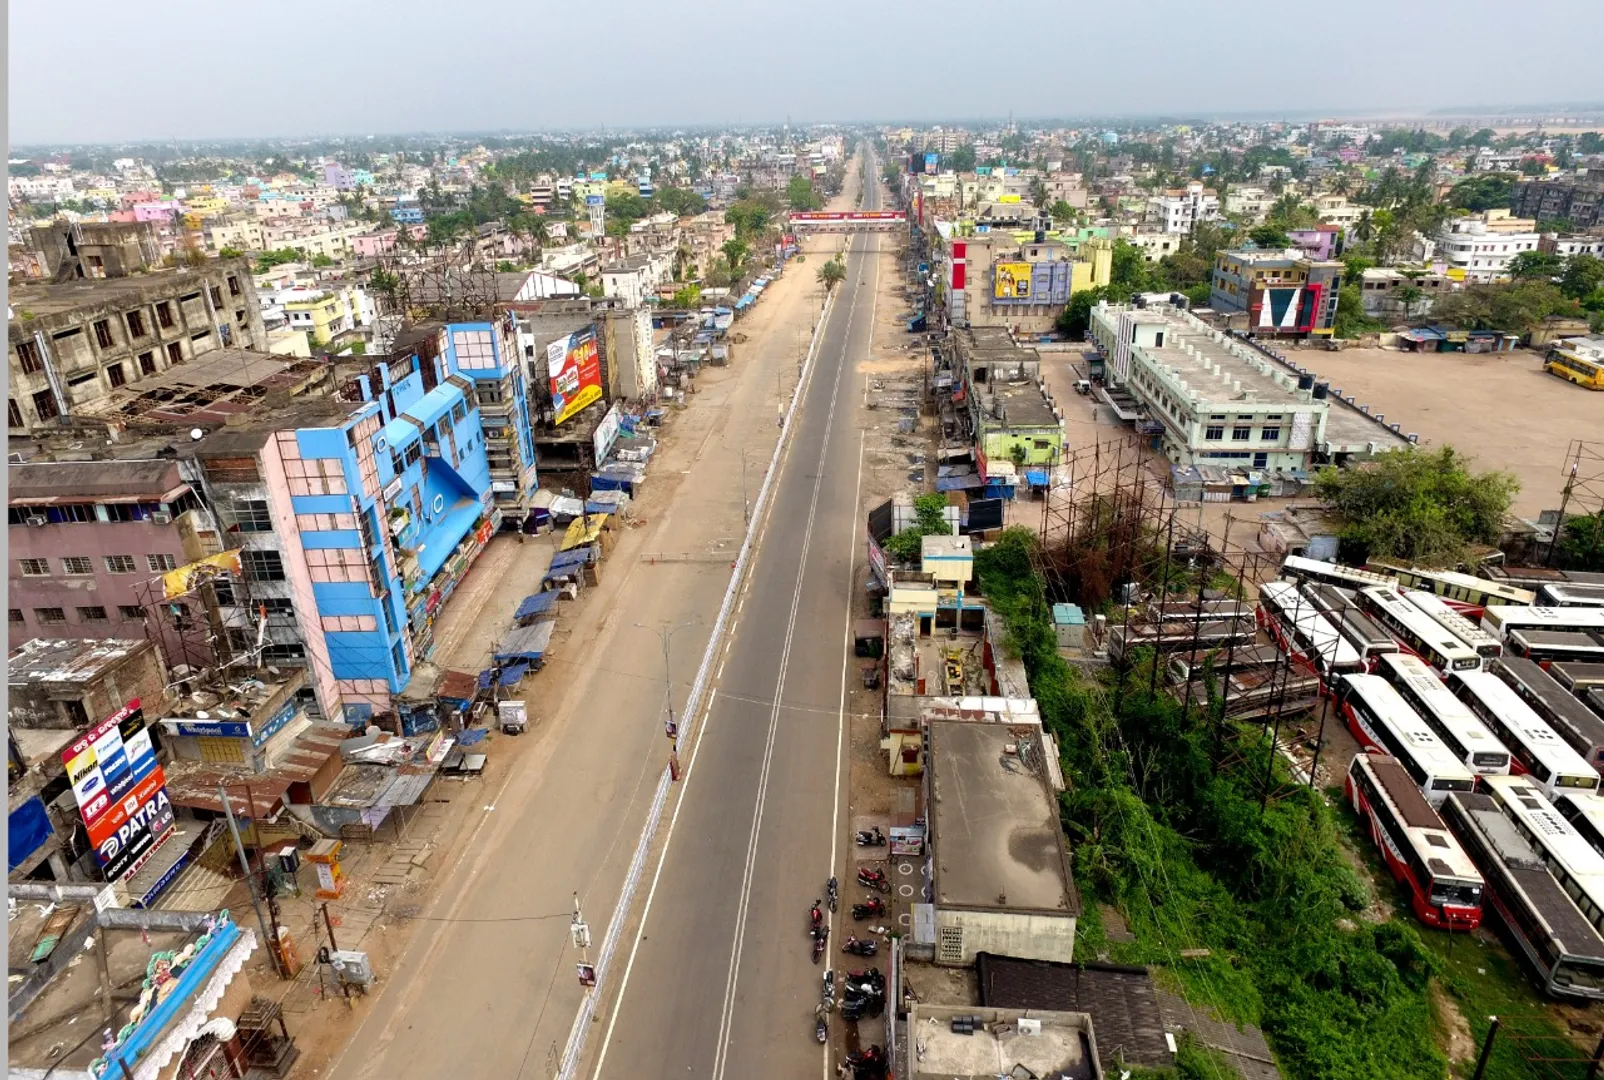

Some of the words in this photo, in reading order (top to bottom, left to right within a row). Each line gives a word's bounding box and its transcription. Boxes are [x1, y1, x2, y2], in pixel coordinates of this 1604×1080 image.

[183, 726, 222, 736] Whirlpool
[73, 760, 98, 783] Nikon
[117, 790, 170, 846] PATRA
[161, 811, 172, 824] LG
